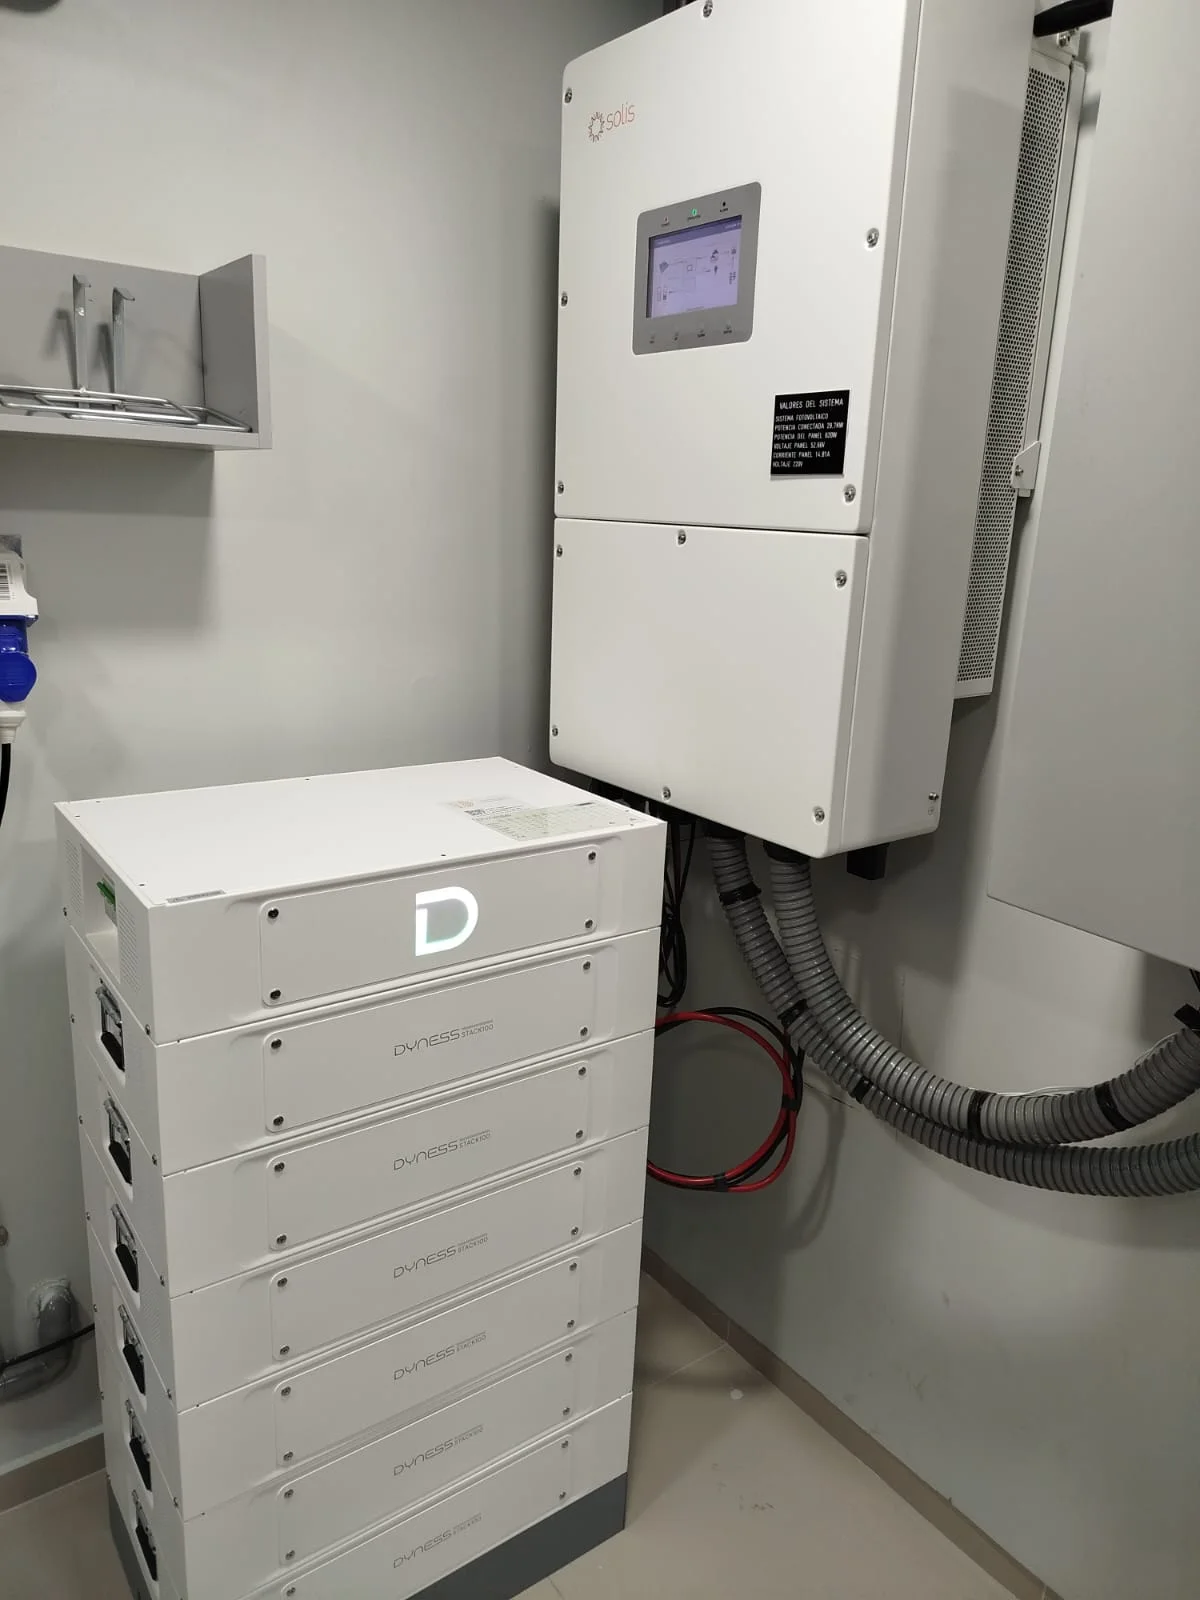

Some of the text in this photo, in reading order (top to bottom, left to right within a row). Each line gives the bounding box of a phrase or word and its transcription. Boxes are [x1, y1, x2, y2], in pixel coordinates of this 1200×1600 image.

[606, 101, 635, 131] solis
[780, 398, 844, 409] VALORES DEL SISTEMA
[774, 442, 792, 450] VOLTAJE
[773, 460, 791, 468] VOLTAJE
[394, 1023, 494, 1057] DYNESS STACK100
[393, 1133, 491, 1170] DYNESS STACK100
[393, 1245, 457, 1278] DYNESS
[393, 1346, 455, 1380] DYNESS
[393, 1439, 454, 1476] DYNESS
[393, 1530, 452, 1568] DYNESS
